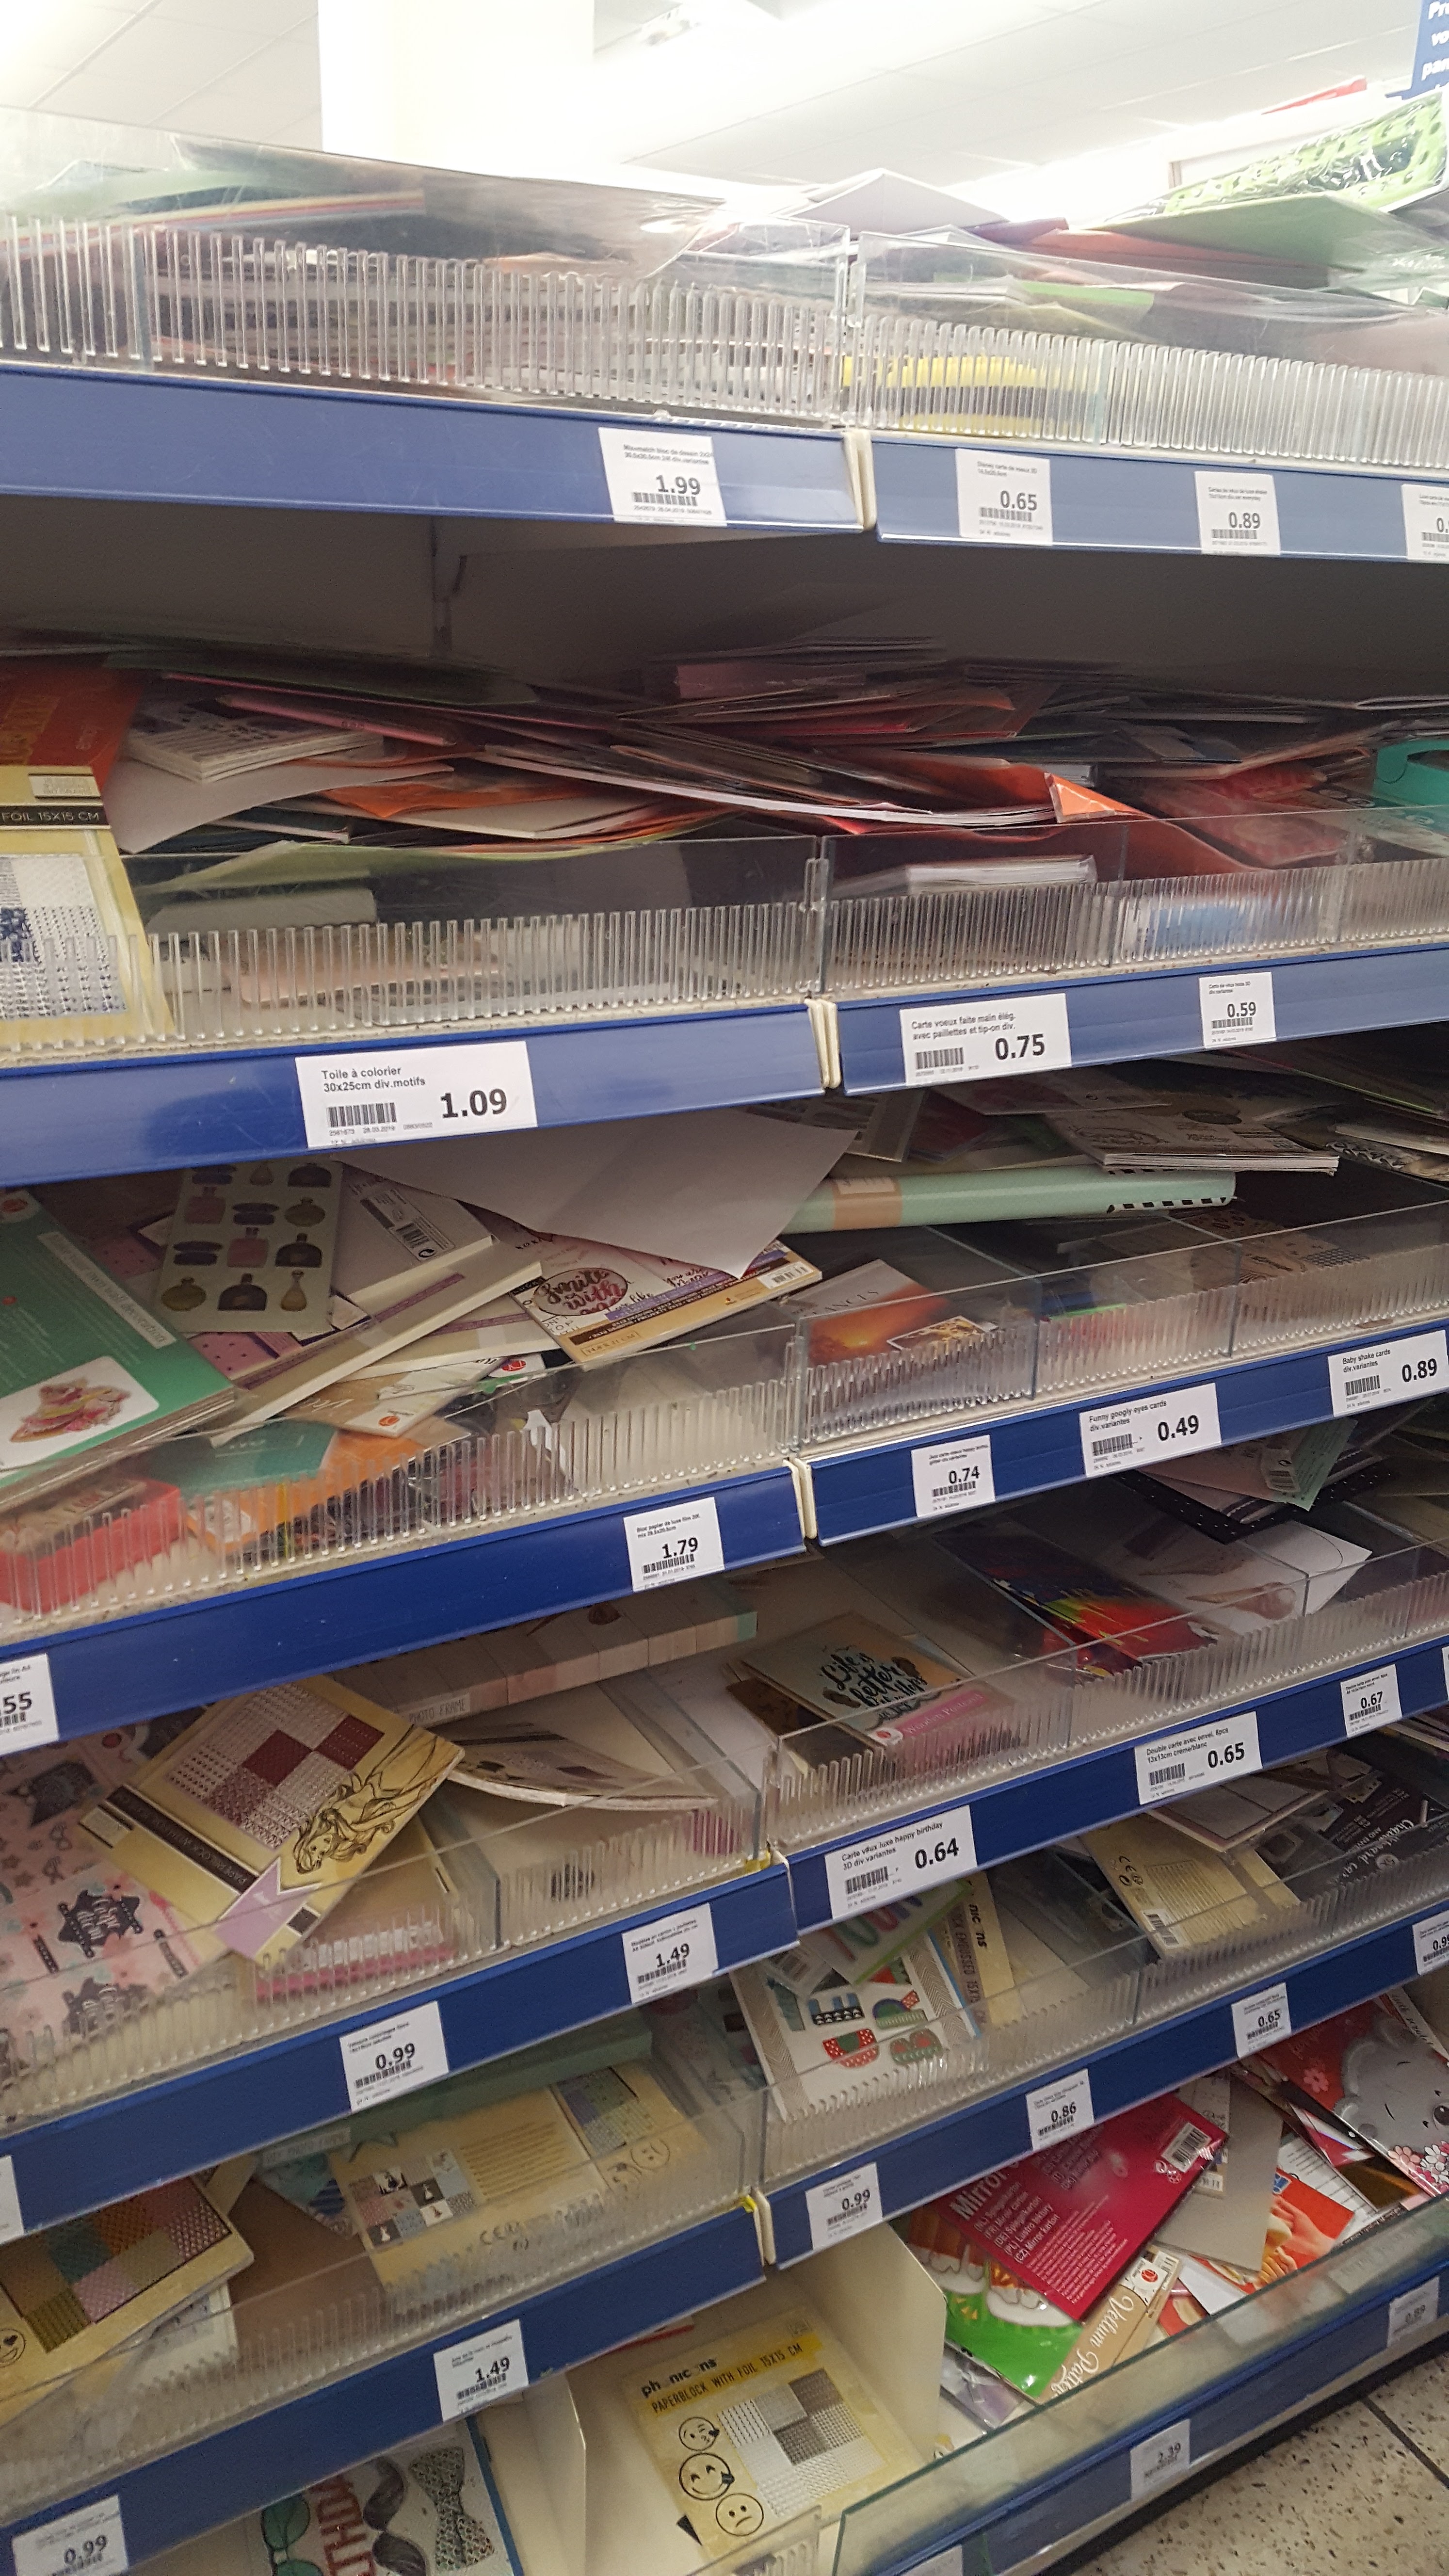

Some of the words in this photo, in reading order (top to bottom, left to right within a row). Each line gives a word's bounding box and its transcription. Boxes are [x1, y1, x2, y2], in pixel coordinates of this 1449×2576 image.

[656, 475, 700, 495] 1.99
[1000, 490, 1037, 511] 0.65
[1229, 512, 1260, 529] 0.89
[1, 812, 34, 822] FOIL
[1227, 1001, 1256, 1017] 0.59
[912, 1021, 932, 1030] Carte
[977, 1014, 996, 1023] main
[913, 1032, 931, 1040] avec
[933, 1028, 967, 1040] paillettes
[995, 1034, 1045, 1060] 0.75
[322, 1070, 348, 1079] Toile
[352, 1068, 357, 1078] à
[361, 1066, 401, 1077] colorier
[323, 1082, 371, 1092] 30x25cm
[374, 1076, 425, 1089] div.motifs
[441, 1088, 507, 1118] 1.09
[1342, 1356, 1357, 1365] Baby
[1358, 1352, 1374, 1361] shake
[1375, 1349, 1391, 1357] cards
[1343, 1360, 1378, 1373] div.variantes
[1402, 1358, 1437, 1383] 0.89
[1089, 1414, 1109, 1423] Funny
[1111, 1408, 1132, 1419] googly
[1133, 1405, 1148, 1414] eyes
[1150, 1400, 1167, 1409] cards
[1090, 1417, 1130, 1432] div.variantes
[1158, 1415, 1199, 1441] 0.49
[949, 1466, 980, 1484] 0.74
[662, 1537, 698, 1559] 1.79
[439, 1699, 466, 1717] FRAME
[1361, 1691, 1383, 1709] 0.67
[1146, 1745, 1167, 1755] Double
[1183, 1737, 1196, 1745] avec
[1208, 1742, 1245, 1768] 0.65
[842, 1850, 860, 1861] Carte
[879, 1838, 893, 1849] luxe
[895, 1831, 915, 1843] happy
[916, 1822, 943, 1836] birthday
[843, 1861, 852, 1870] 3D
[866, 1848, 896, 1861] variantes
[915, 1837, 959, 1869] 0.64
[656, 1943, 690, 1968] 1.49
[1258, 2009, 1280, 2027] 0.65
[375, 2043, 415, 2070] 0.99
[1051, 2102, 1077, 2123] 0.86
[841, 2189, 870, 2211] 0.99
[949, 2170, 1008, 2221] Mirror
[994, 2231, 1010, 2248] (DE)
[1004, 2240, 1020, 2256] (PL)
[1015, 2221, 1036, 2243] Lustro
[1014, 2247, 1031, 2265] (CZ)
[1025, 2230, 1045, 2251] Mirror
[1039, 2212, 1061, 2234] karton
[1089, 2296, 1134, 2348] Vellum
[476, 2357, 510, 2383] 1.49
[651, 2383, 709, 2414] PAPERBLOCK
[711, 2370, 735, 2388] WITH
[737, 2362, 757, 2378] FOIL
[759, 2350, 786, 2367] 15X15
[788, 2342, 803, 2356] CM
[64, 2535, 108, 2564] 0.99
